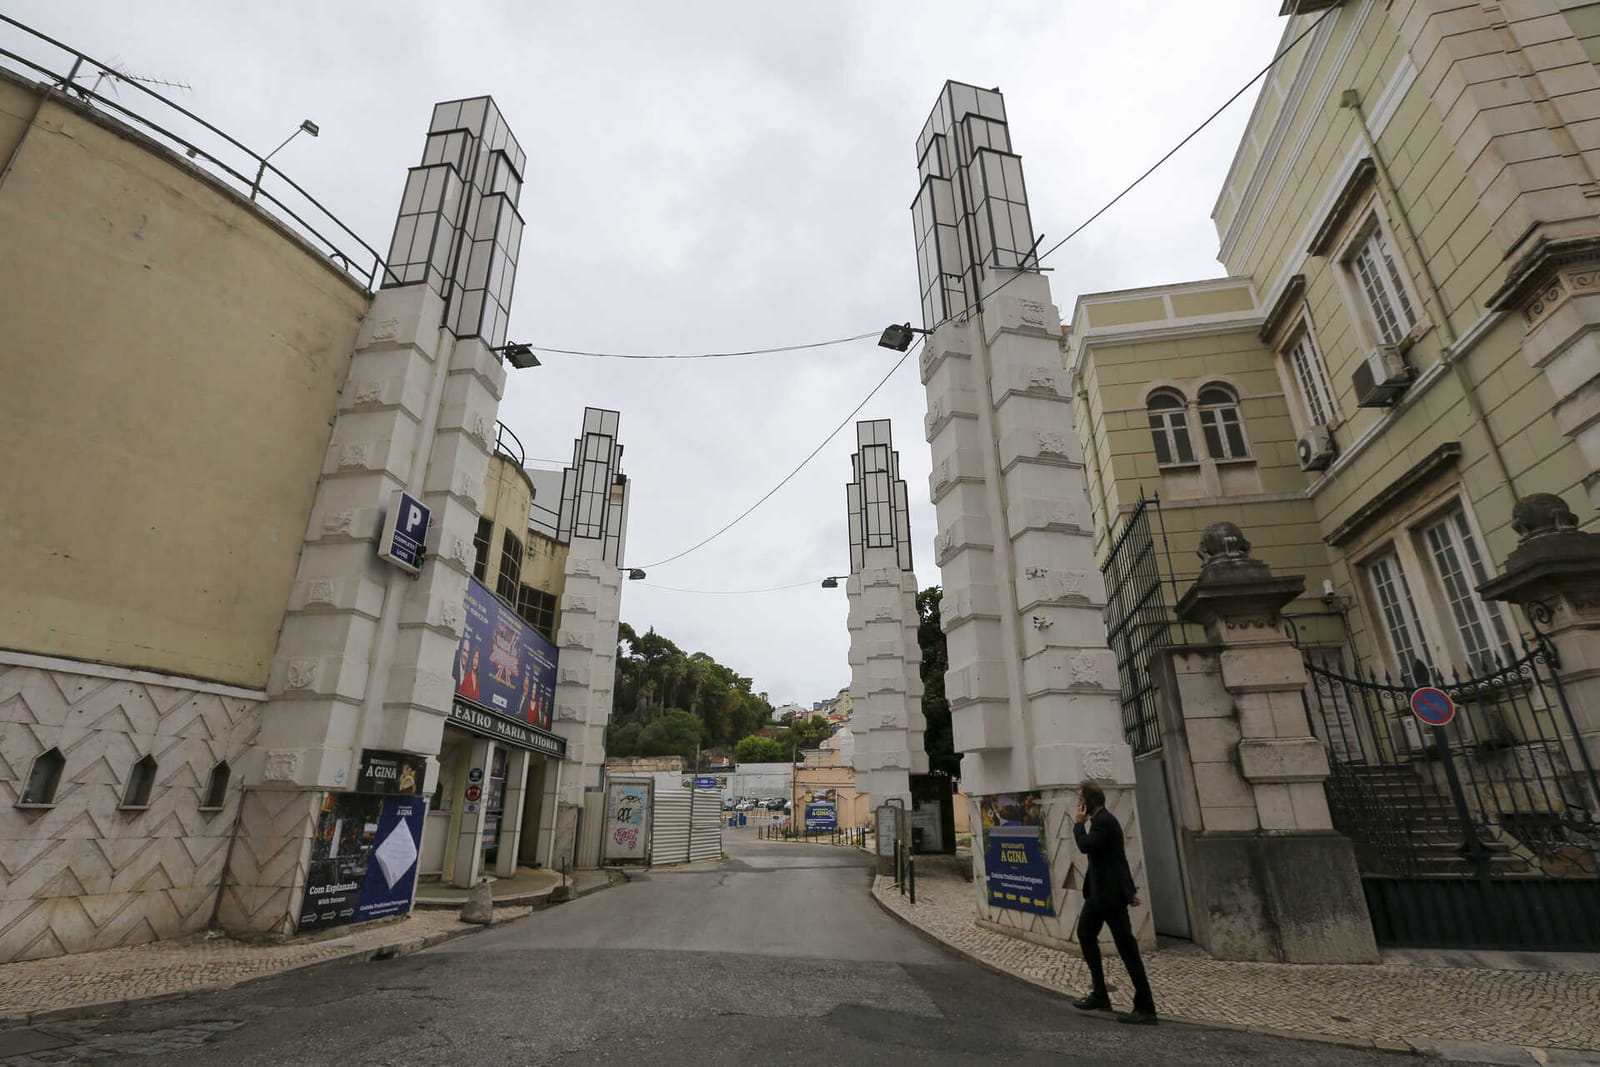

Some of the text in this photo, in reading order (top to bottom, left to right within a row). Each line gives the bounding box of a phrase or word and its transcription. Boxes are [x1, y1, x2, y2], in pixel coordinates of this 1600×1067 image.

[406, 504, 422, 533] P
[497, 721, 526, 741] MARIA
[366, 765, 397, 779] A GINA
[1001, 850, 1028, 864] A GINA
[309, 881, 358, 895] Com Esplanada
